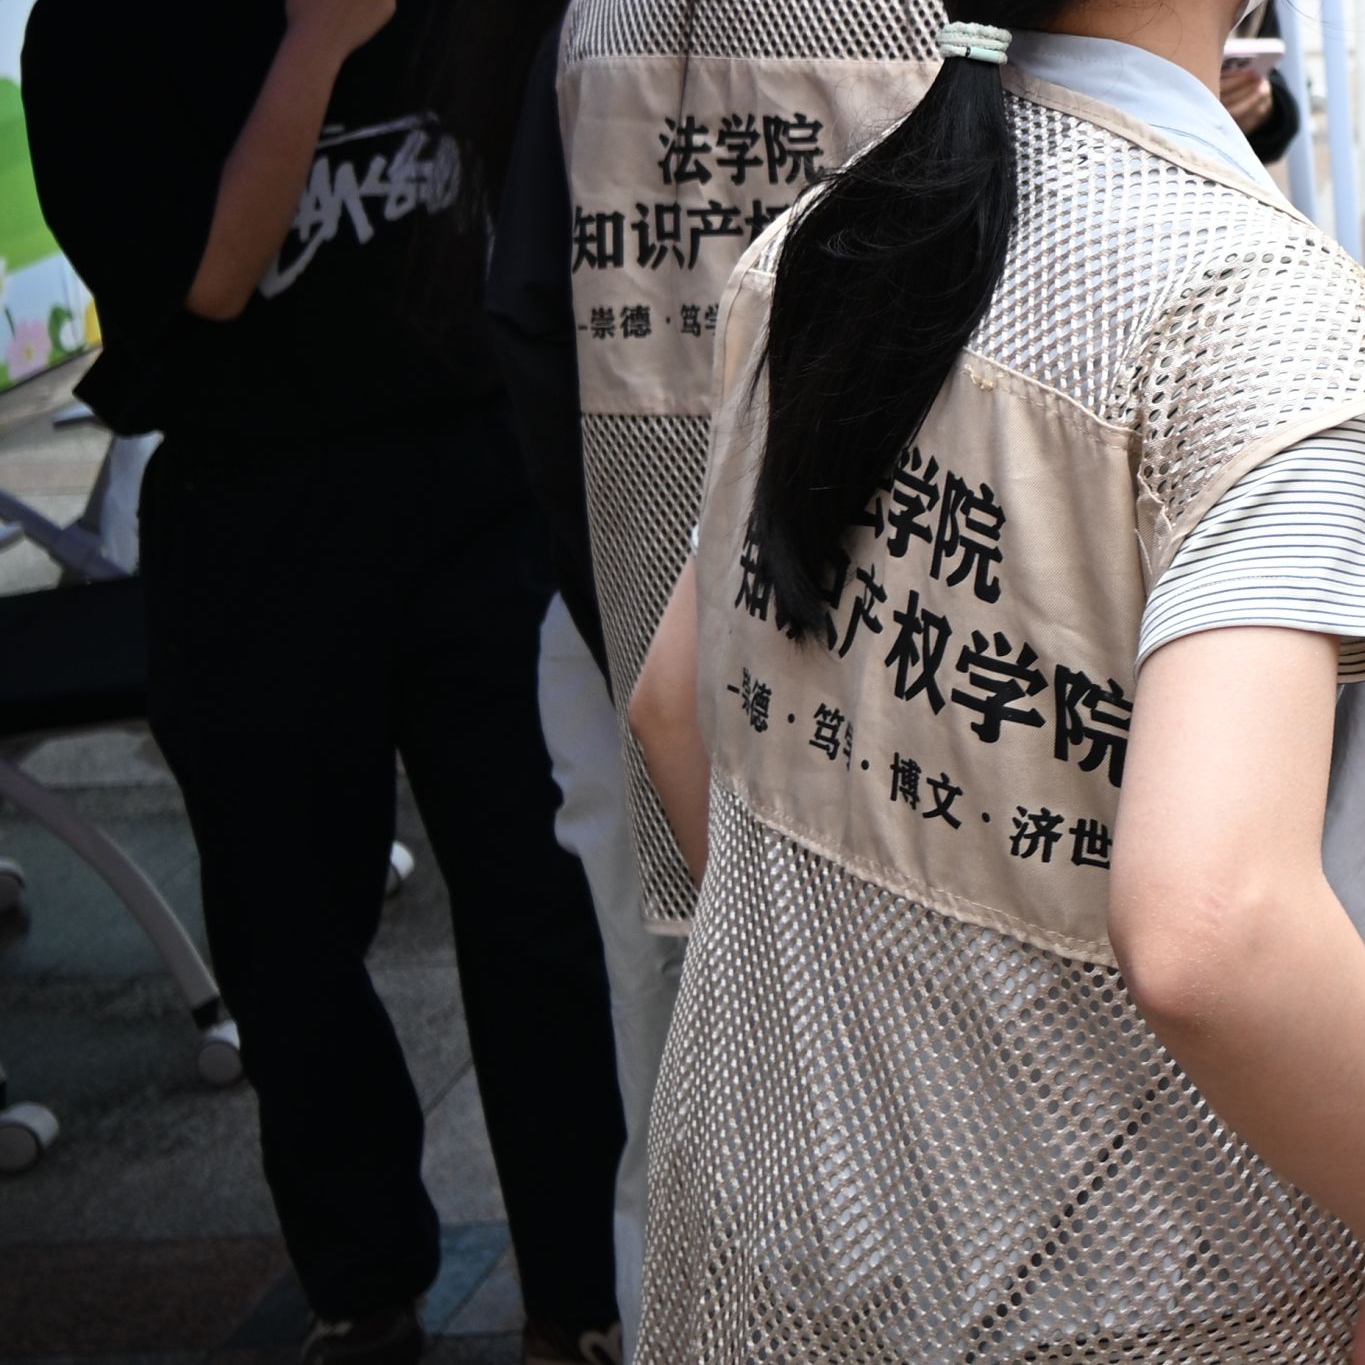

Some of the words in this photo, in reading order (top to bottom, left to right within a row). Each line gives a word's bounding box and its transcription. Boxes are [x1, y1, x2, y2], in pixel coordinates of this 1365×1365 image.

[657, 113, 824, 186] 法学院
[851, 446, 1007, 605] 学院
